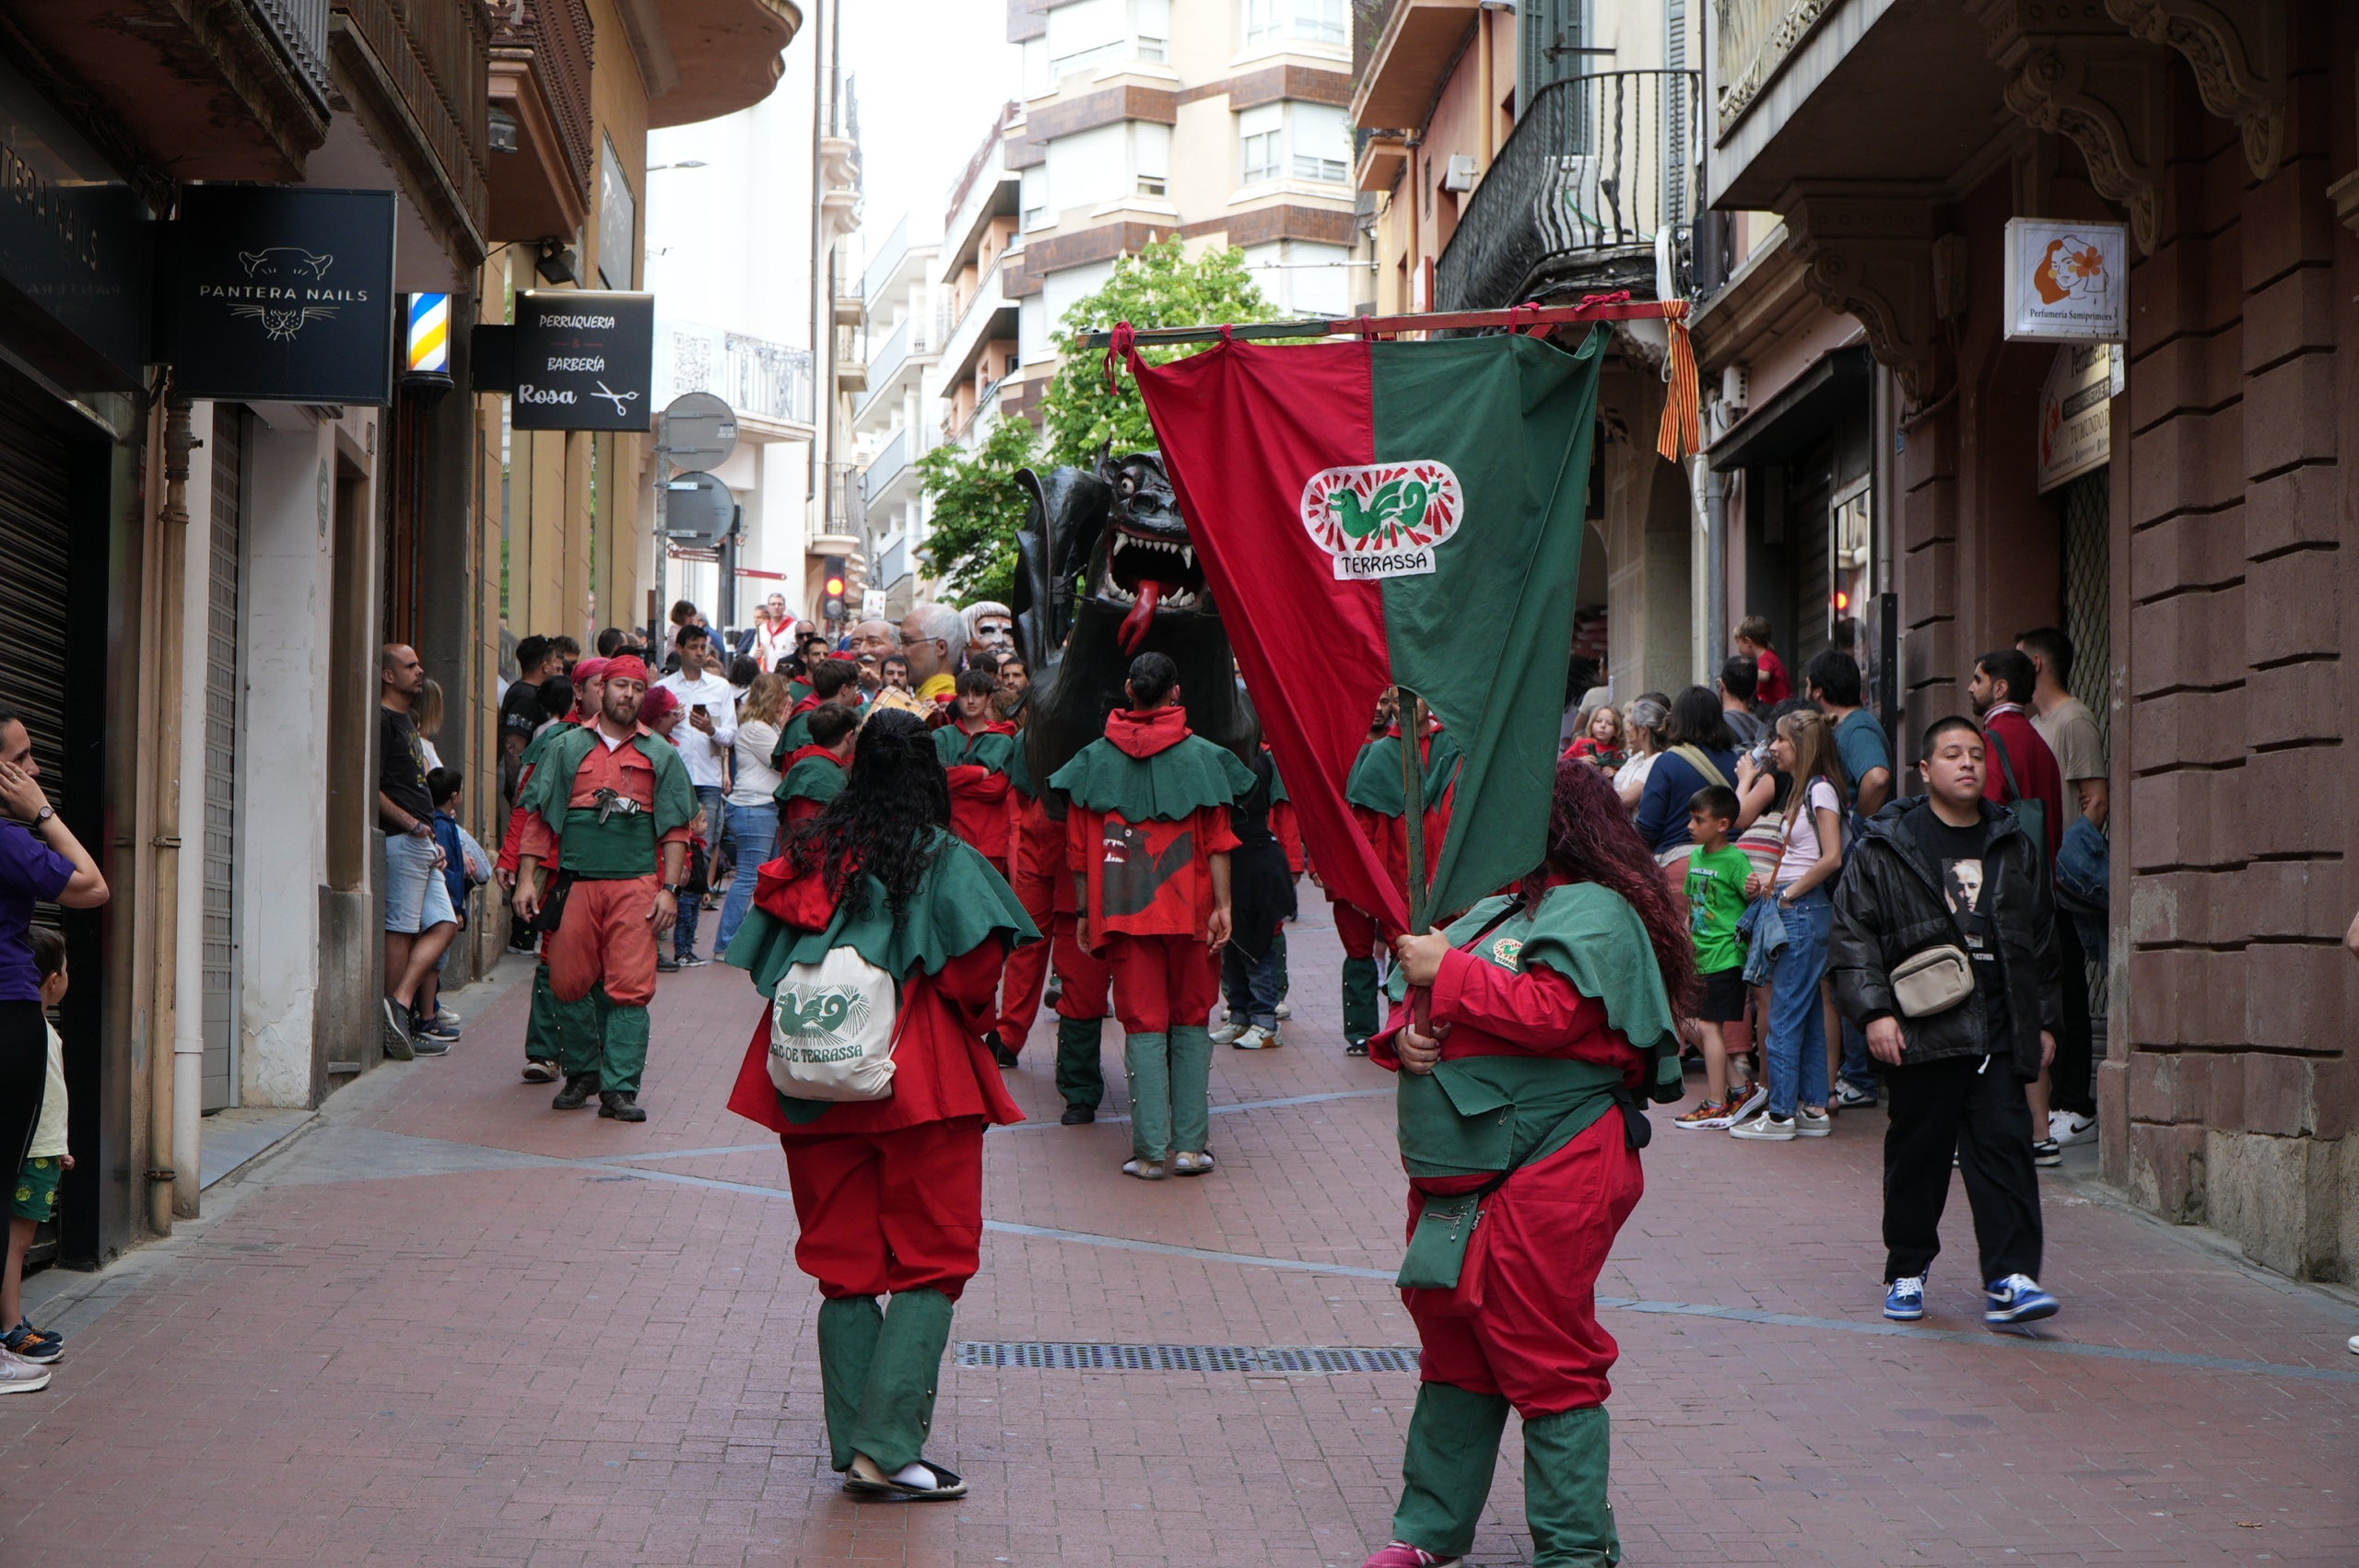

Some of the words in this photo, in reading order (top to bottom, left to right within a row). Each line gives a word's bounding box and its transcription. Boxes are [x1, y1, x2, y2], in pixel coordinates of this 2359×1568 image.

[200, 285, 297, 299] PANTERA
[307, 288, 368, 301] NAILS
[539, 314, 616, 330] PERRUQUERIA
[547, 356, 605, 372] BARBERÍA
[518, 384, 578, 404] Rosa
[1342, 553, 1427, 575] TERRASSA
[786, 1047, 799, 1062] DE
[801, 1045, 863, 1063] TERRASSA
